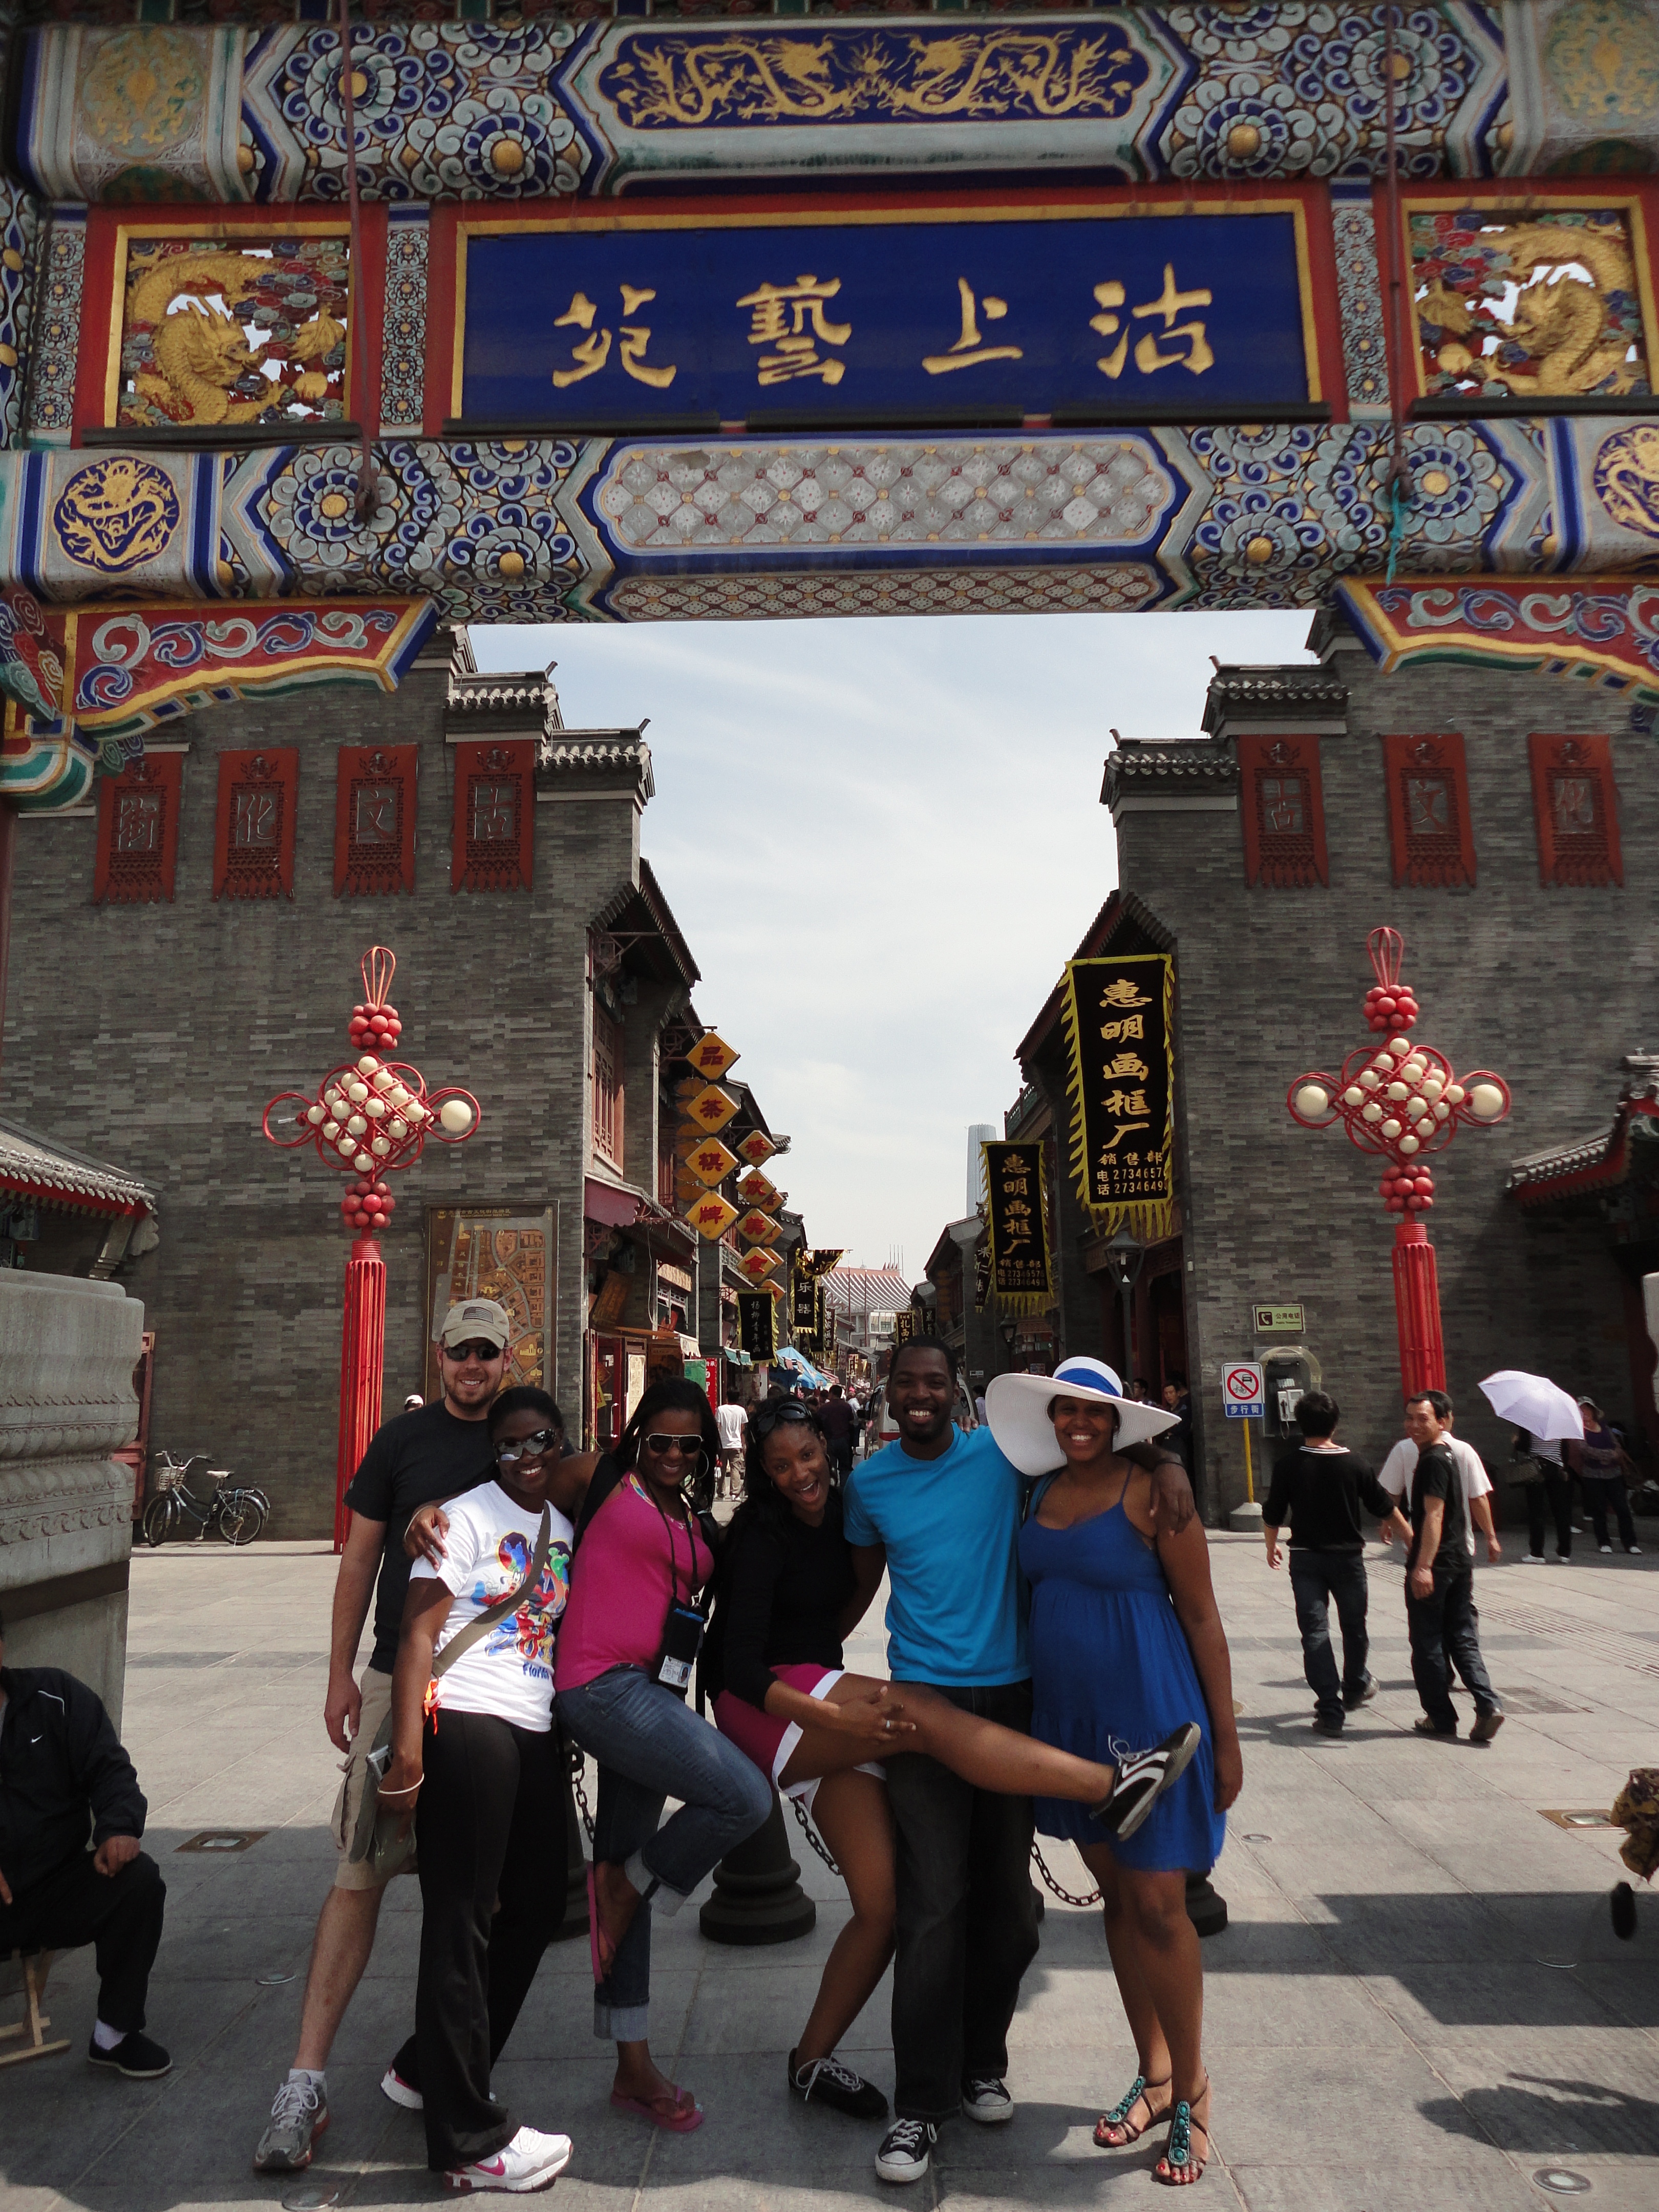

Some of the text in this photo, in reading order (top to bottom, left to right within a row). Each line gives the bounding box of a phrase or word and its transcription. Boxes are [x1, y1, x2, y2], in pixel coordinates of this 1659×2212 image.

[1099, 979, 1153, 1150] 惠明画框厂
[1097, 1150, 1163, 1165] 销售部
[1113, 1167, 1165, 1180] 2734657
[1114, 1181, 1166, 1194] 2734649
[1002, 1154, 1032, 1254] 惠明画框厂
[797, 1281, 813, 1314] 乐器
[1230, 1405, 1259, 1414] 步行街
